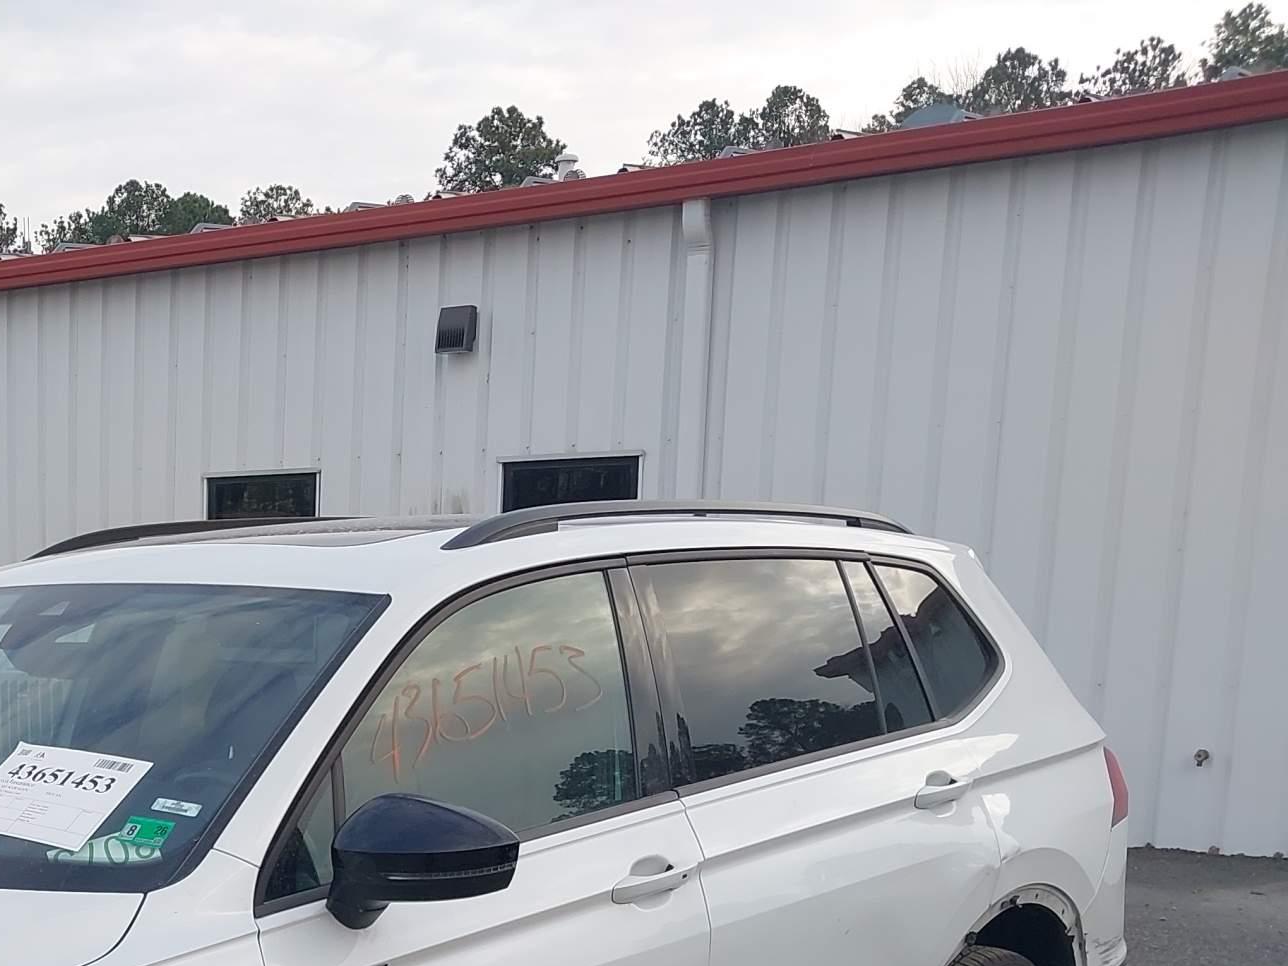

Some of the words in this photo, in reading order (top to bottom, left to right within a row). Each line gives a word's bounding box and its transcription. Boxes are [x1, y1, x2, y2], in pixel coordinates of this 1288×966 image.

[369, 645, 603, 784] 43651453
[7, 763, 117, 794] 43651453
[126, 824, 138, 837] 8
[153, 824, 170, 836] 26
